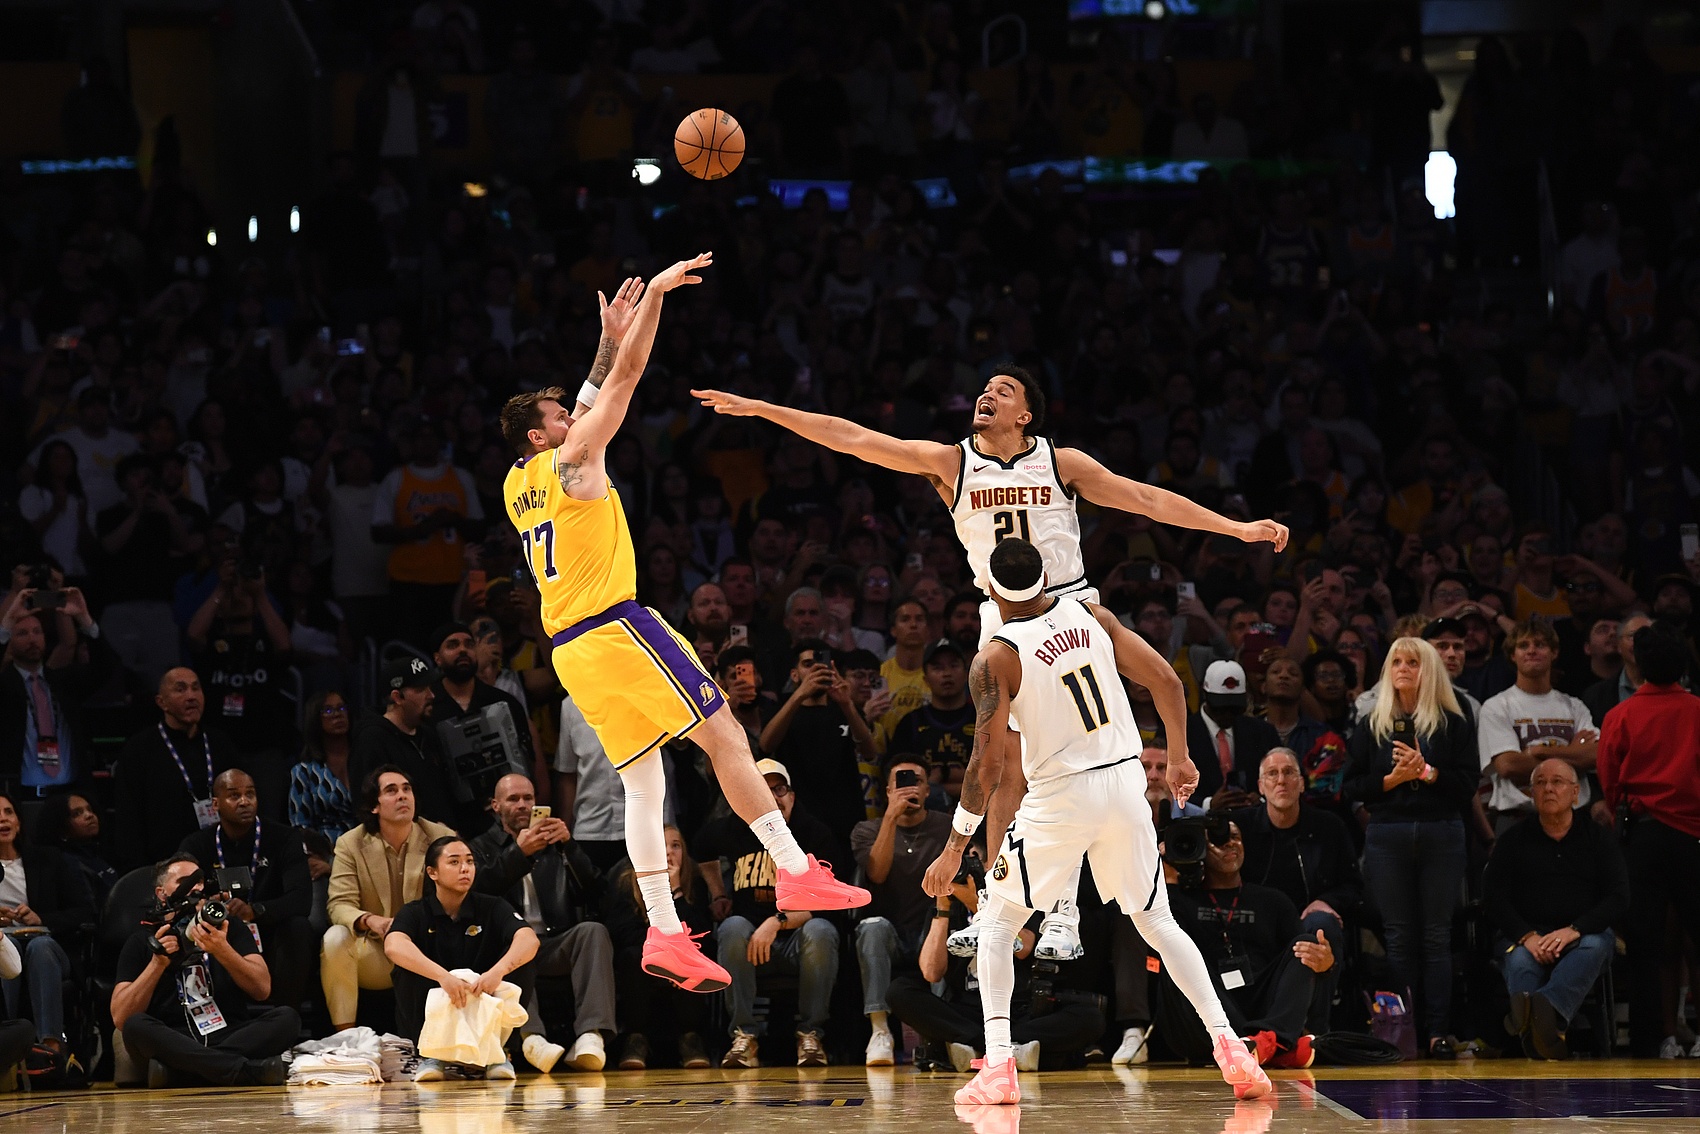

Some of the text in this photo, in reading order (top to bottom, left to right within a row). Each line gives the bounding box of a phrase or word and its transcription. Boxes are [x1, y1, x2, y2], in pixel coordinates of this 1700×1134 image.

[512, 485, 547, 519] DONČIĆ
[969, 485, 1053, 511] NUGGETS
[993, 509, 1031, 545] 21
[1034, 627, 1091, 667] BROWN
[1060, 662, 1111, 735] 11
